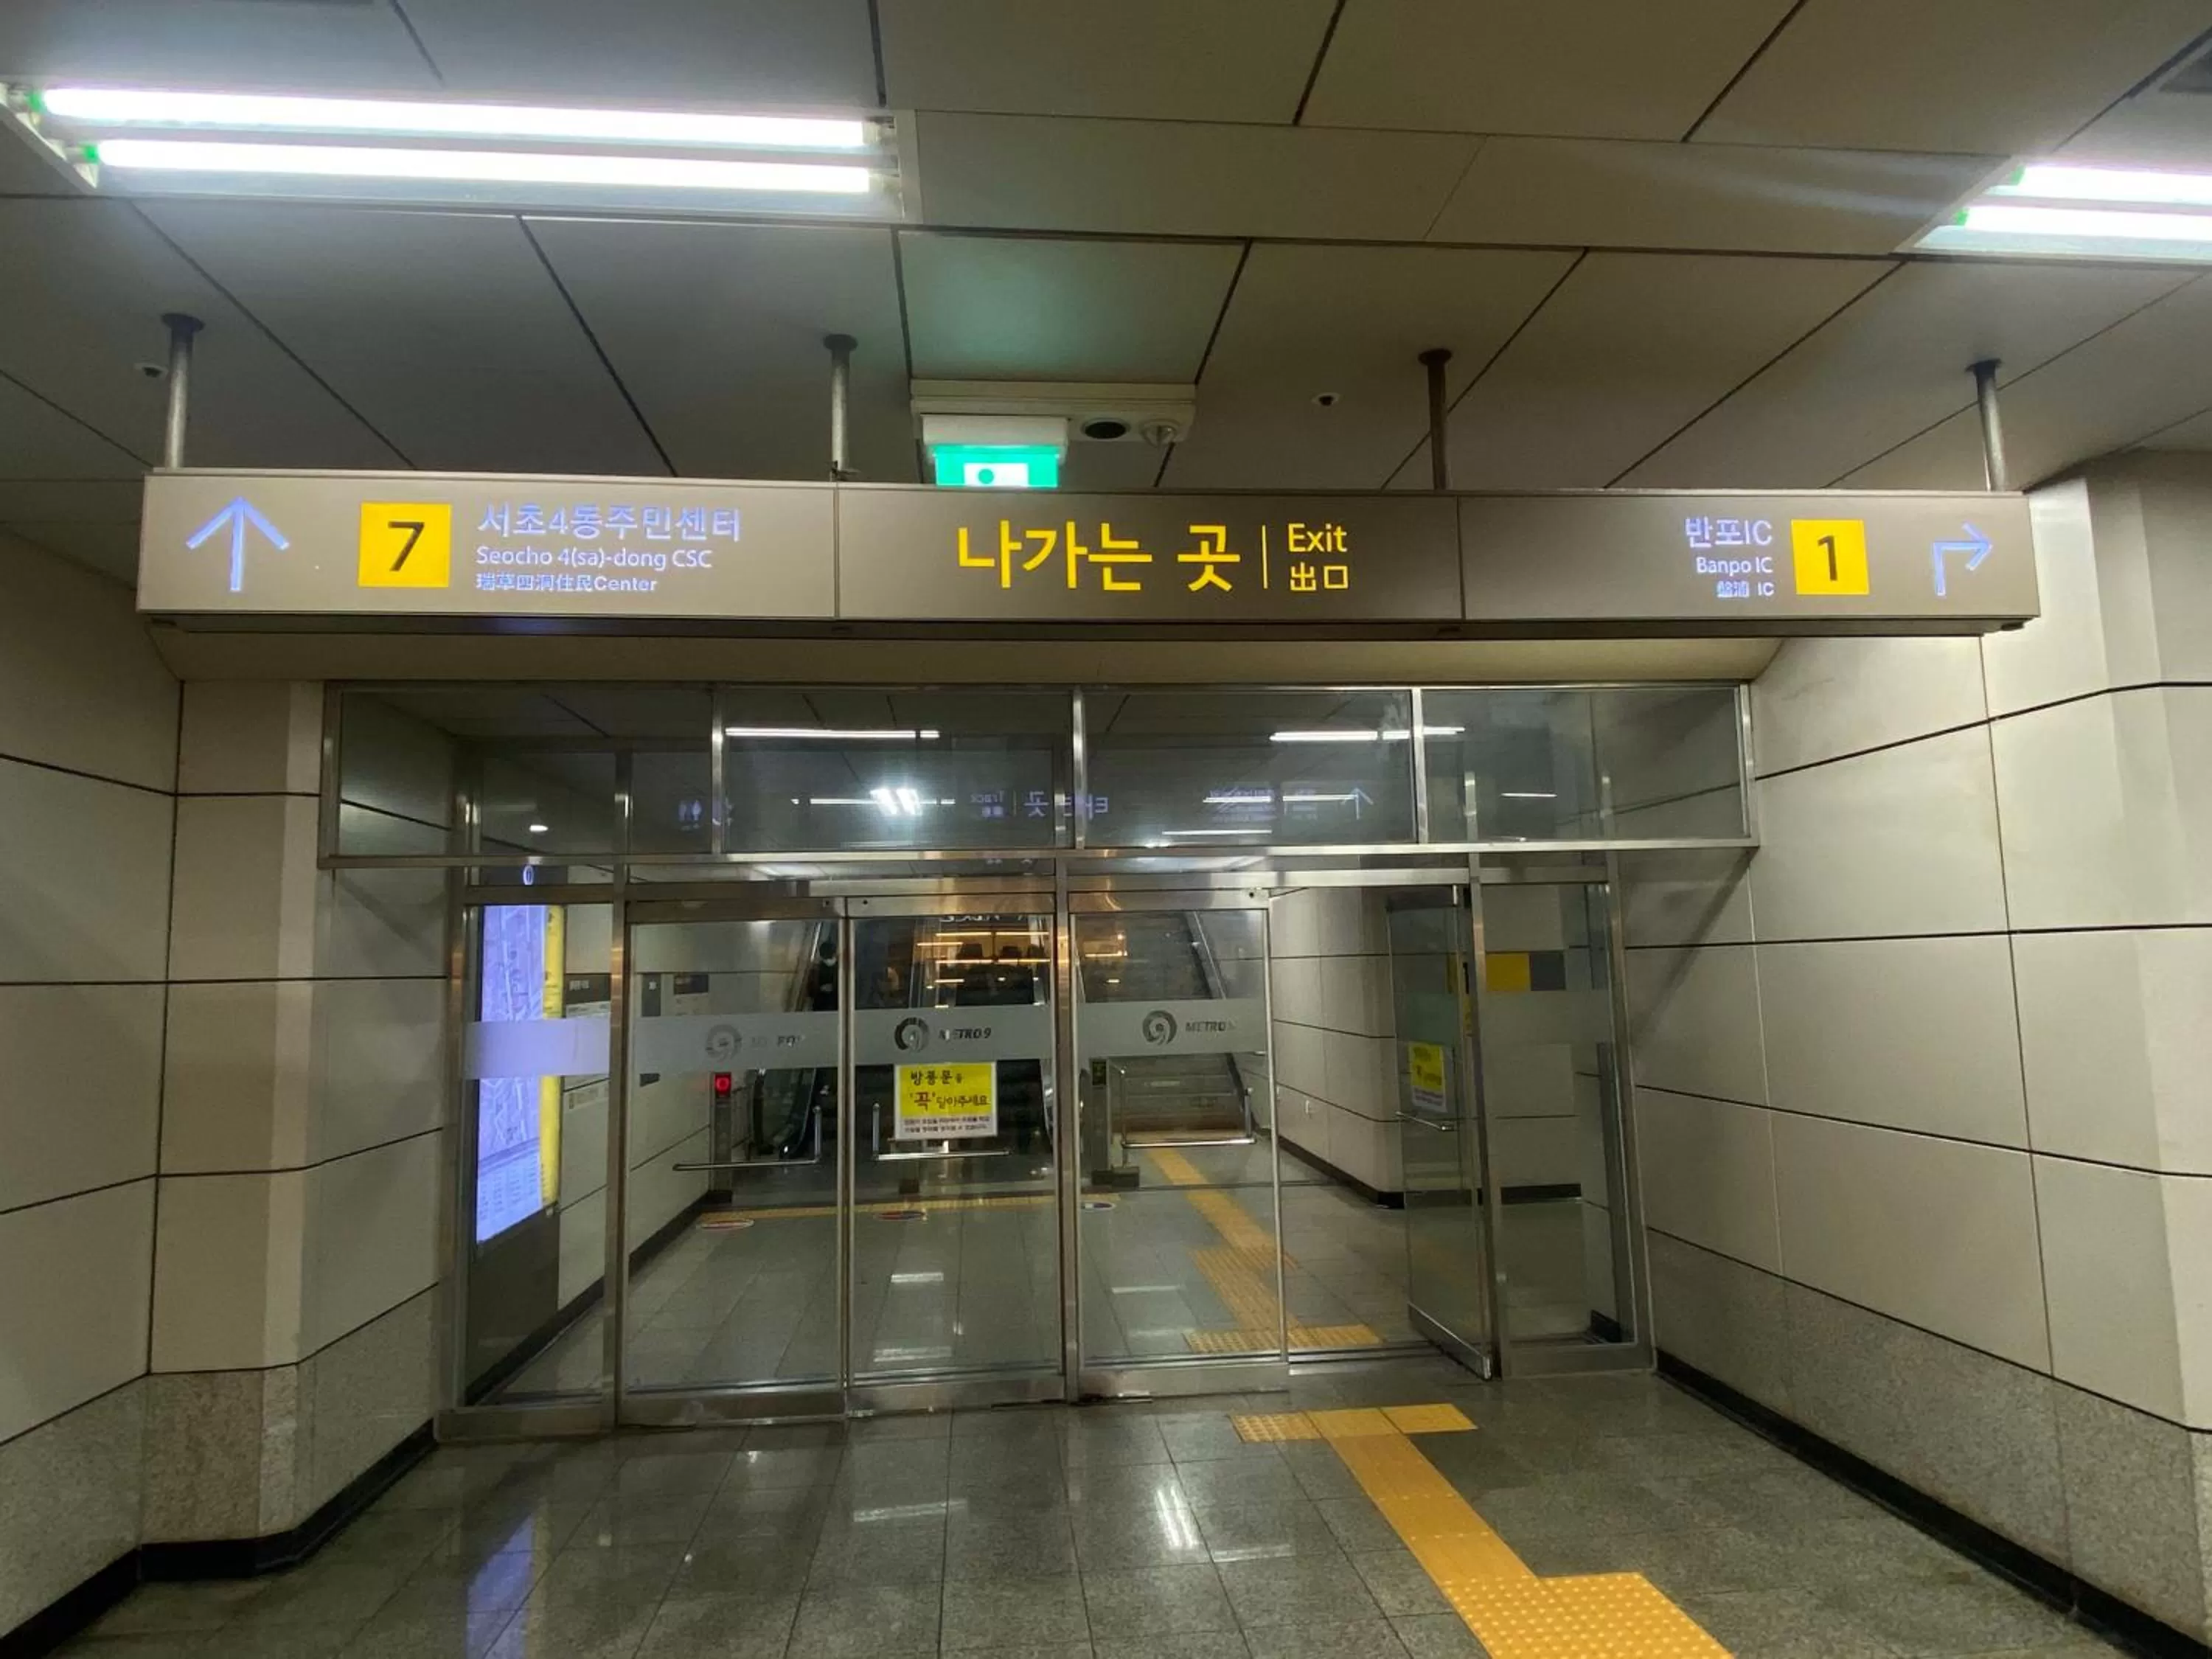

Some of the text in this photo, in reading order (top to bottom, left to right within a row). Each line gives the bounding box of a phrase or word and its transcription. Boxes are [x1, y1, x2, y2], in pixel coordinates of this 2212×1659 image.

[478, 501, 740, 543] 서초4동주민센터
[1685, 516, 1773, 548] 반포IC
[386, 521, 425, 572] 7
[1288, 523, 1348, 553] Exit
[476, 546, 713, 571] Seocho 4(sa)-dong CSC
[958, 520, 1241, 591] 나가는 곳
[1697, 557, 1773, 576] Banpo IC
[1817, 535, 1838, 582] 1
[1290, 561, 1349, 591] 出口
[1757, 582, 1775, 597] IC
